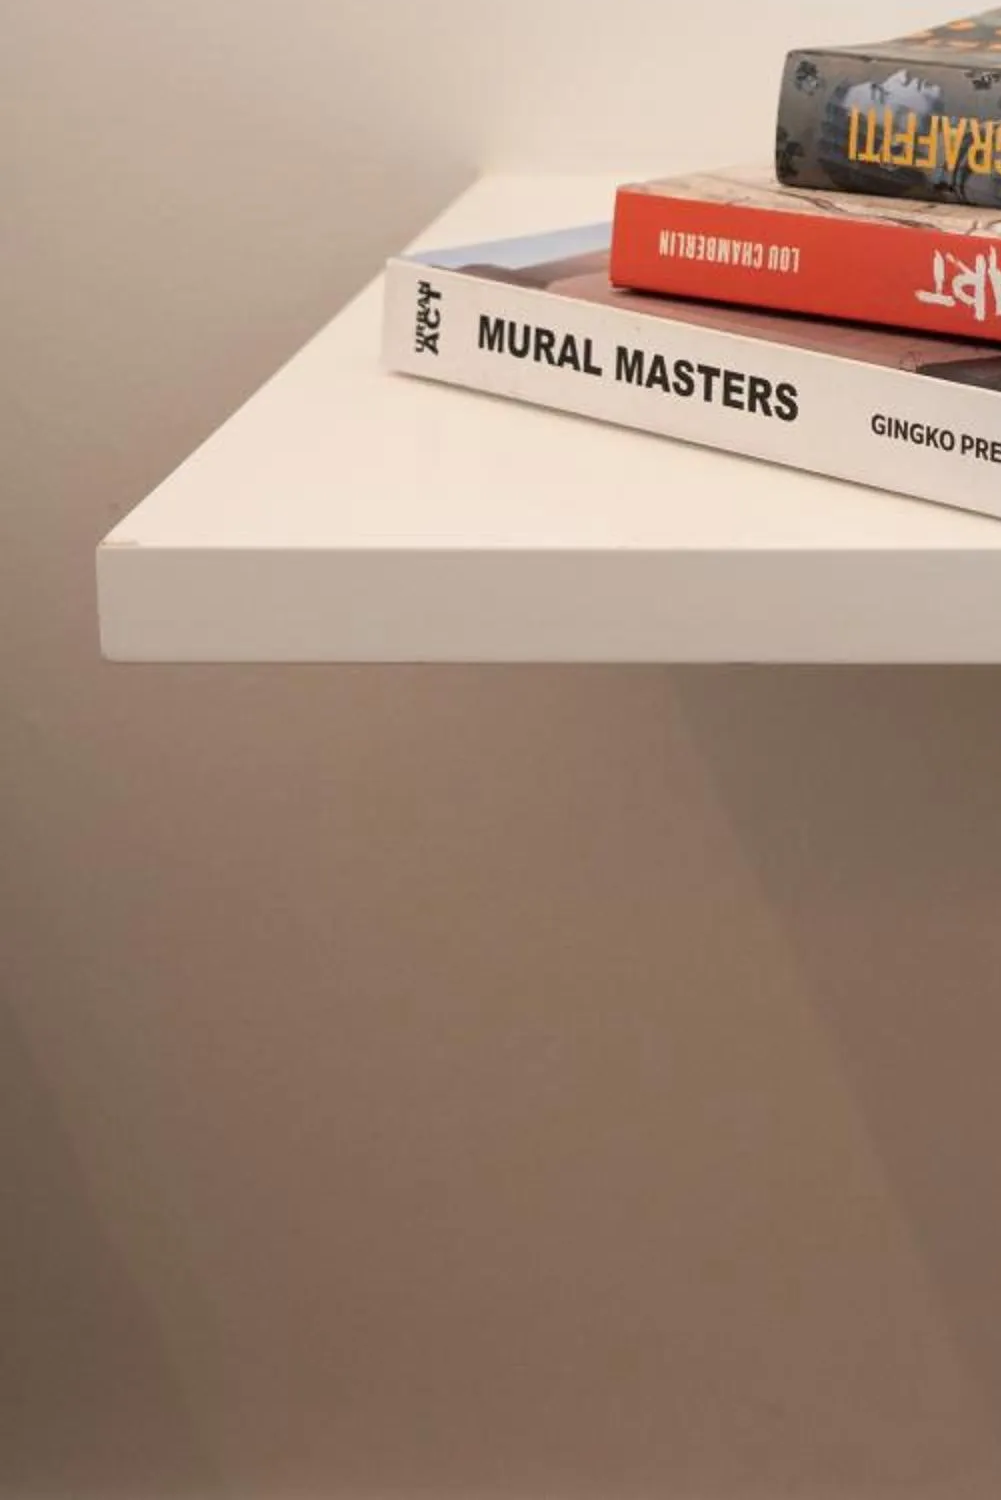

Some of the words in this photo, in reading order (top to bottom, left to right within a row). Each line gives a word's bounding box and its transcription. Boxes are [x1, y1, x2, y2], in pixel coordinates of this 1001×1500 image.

[658, 229, 763, 269] CHAMBERLIN
[768, 245, 800, 273] LOU
[478, 314, 602, 376] MURAL
[615, 346, 799, 422] MASTERS
[871, 414, 953, 453] GINGKO
